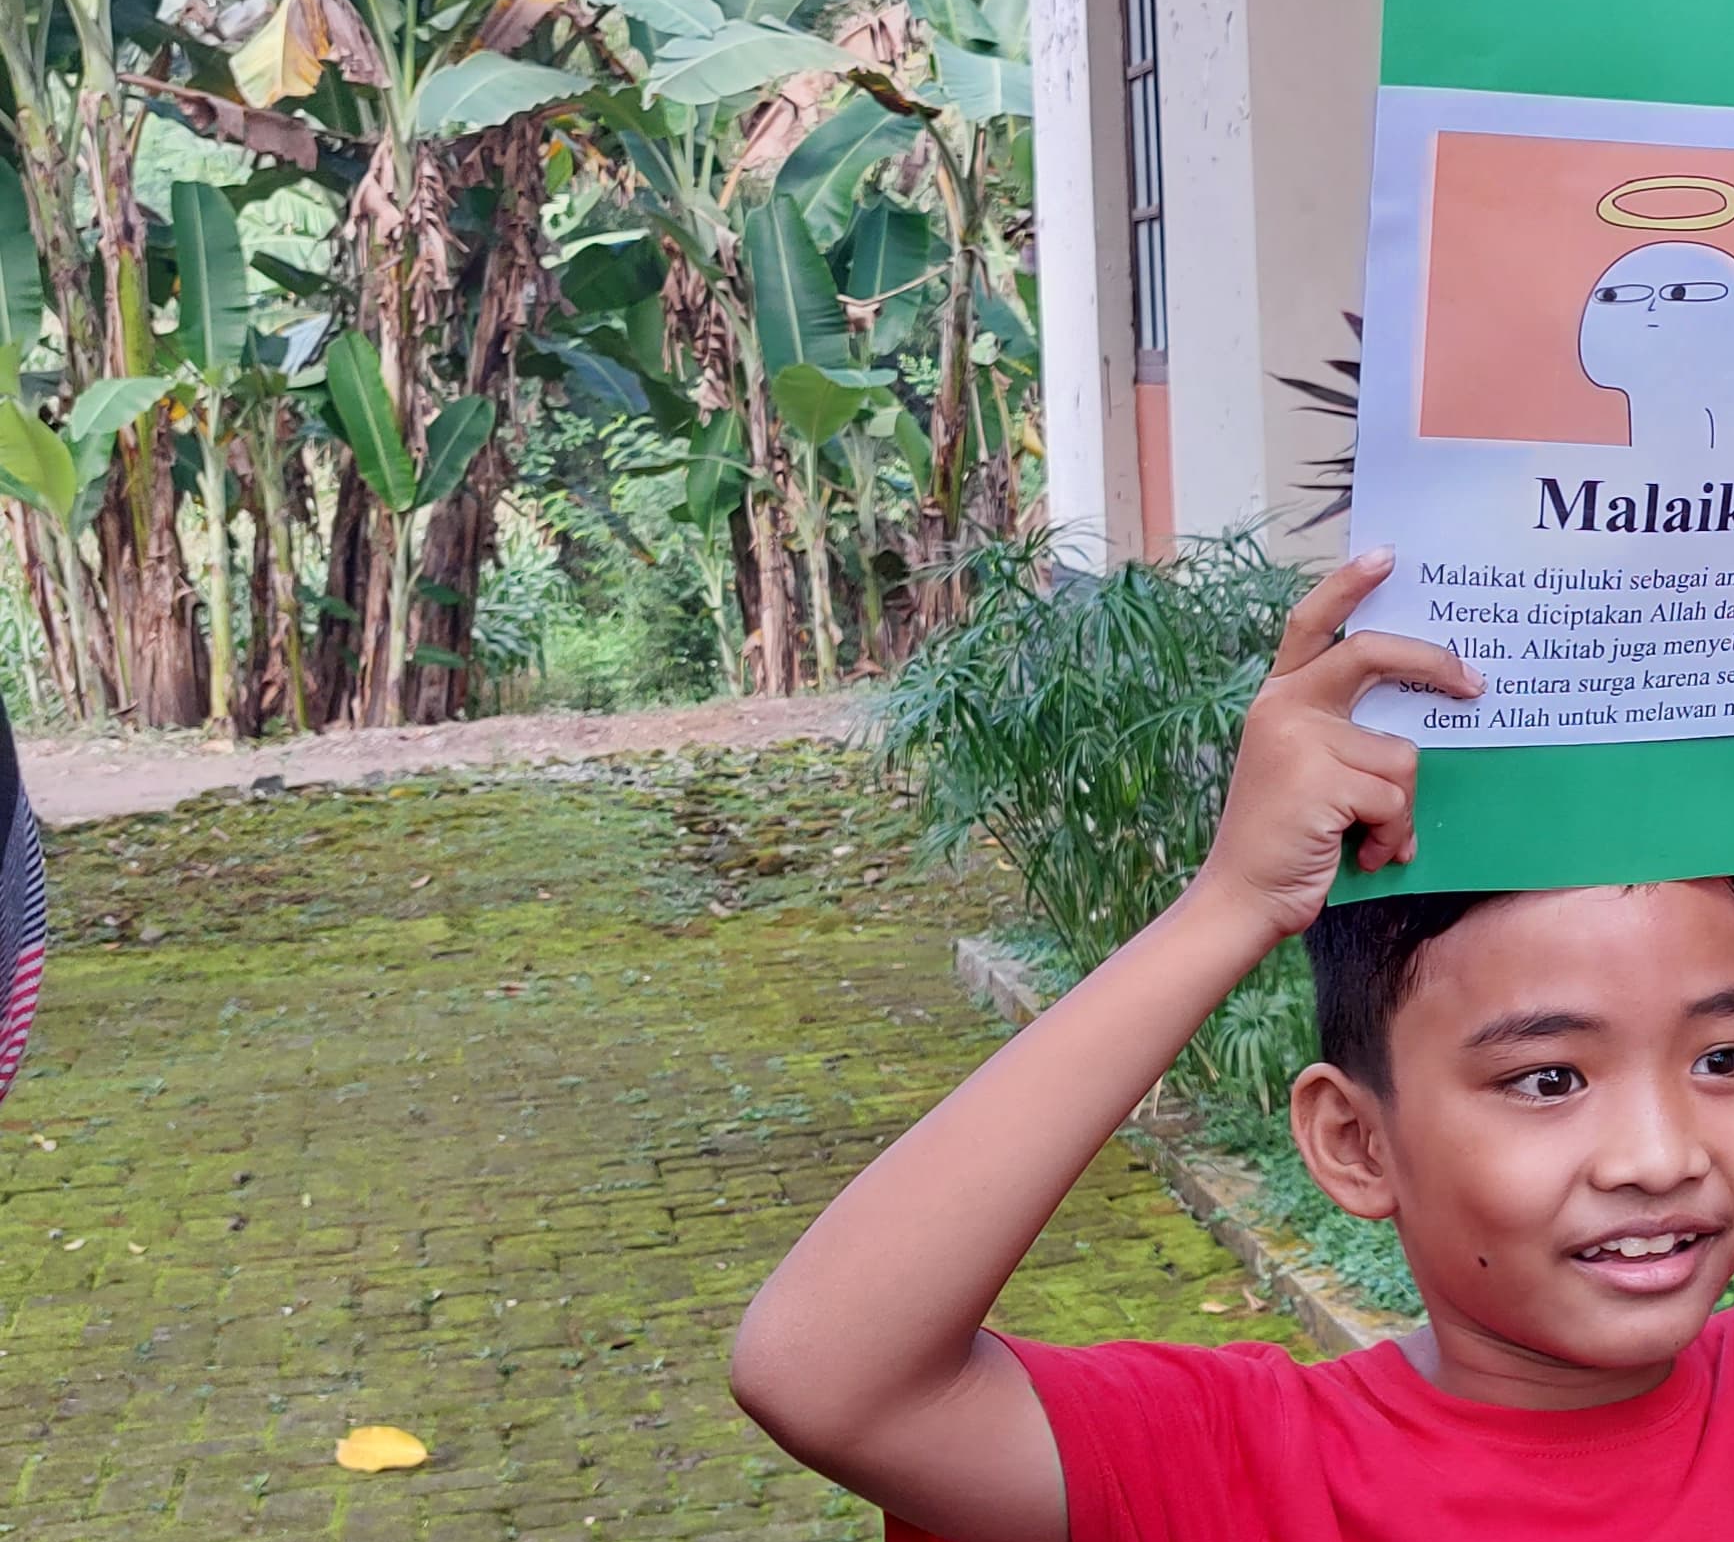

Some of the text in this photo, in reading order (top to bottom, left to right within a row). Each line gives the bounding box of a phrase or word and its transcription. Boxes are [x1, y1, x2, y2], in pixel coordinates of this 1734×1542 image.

[1419, 562, 1526, 588] Malaikat
[1533, 567, 1623, 595] dijuluki
[1629, 566, 1709, 594] sebagai
[1427, 600, 1518, 624] Mereka
[1527, 603, 1642, 631] diciptakan
[1649, 600, 1706, 623] Allah
[1446, 637, 1512, 659] Allah.
[1520, 638, 1605, 660] Alkitab
[1607, 637, 1657, 664] juga
[1496, 676, 1571, 695] tentara
[1577, 675, 1635, 697] surga
[1641, 669, 1710, 690] karena
[1423, 708, 1480, 729] demi
[1487, 707, 1550, 729] Allah
[1558, 704, 1618, 727] untuk
[1625, 701, 1716, 723] melawan
